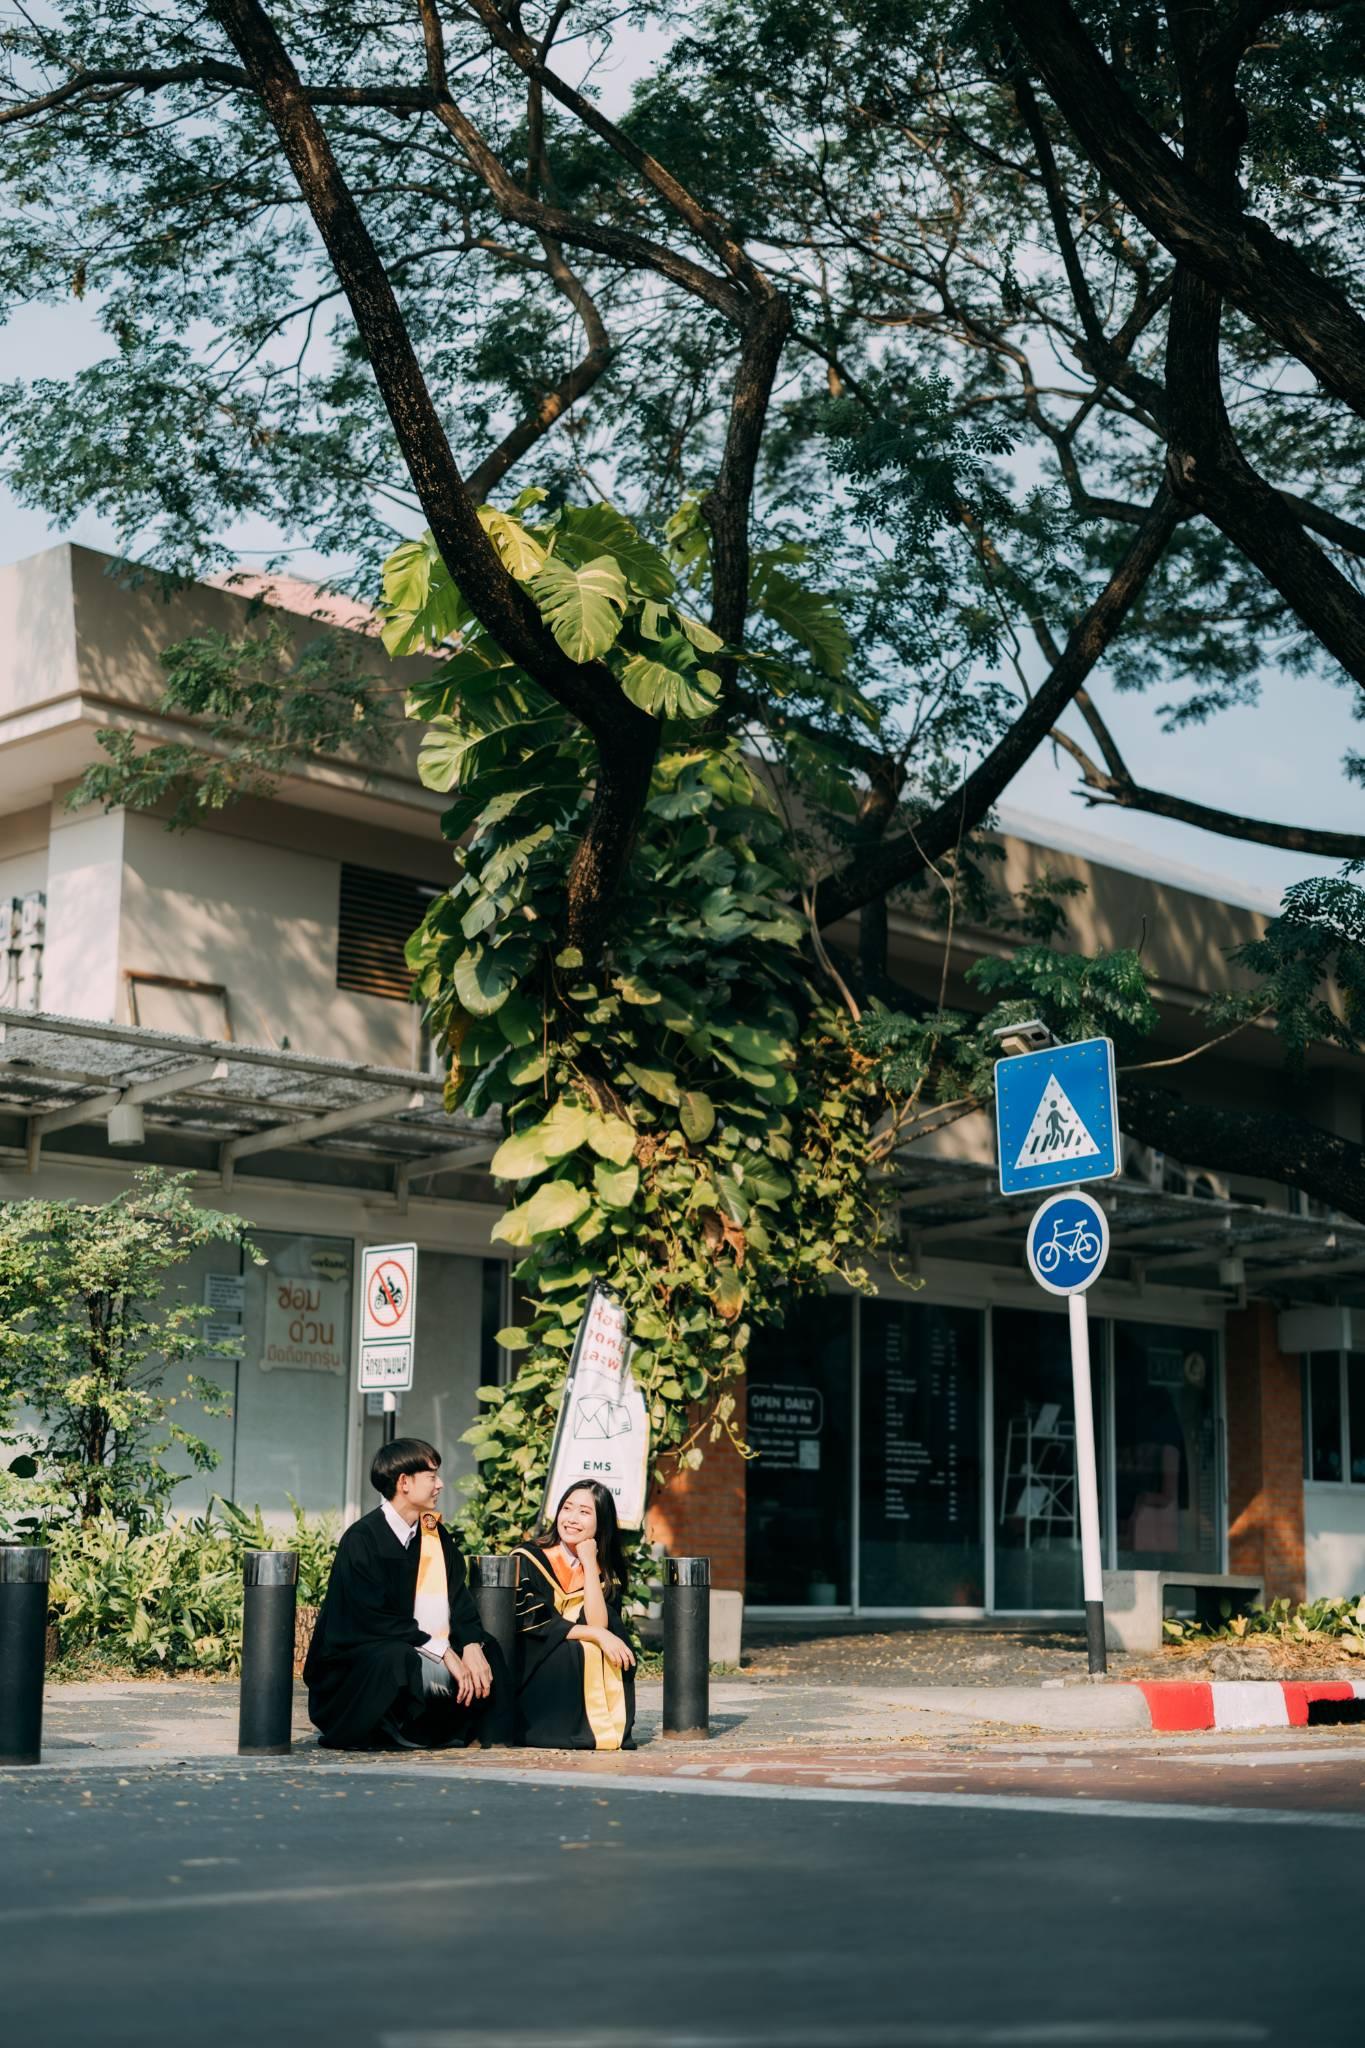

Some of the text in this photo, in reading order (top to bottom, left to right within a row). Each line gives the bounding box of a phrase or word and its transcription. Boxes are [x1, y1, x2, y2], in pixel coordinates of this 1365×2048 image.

[277, 1281, 321, 1312] ซ่อม
[288, 1314, 335, 1345] ด่วน
[750, 1394, 815, 1411] OPEN DAILY
[583, 1460, 612, 1471] EMS
